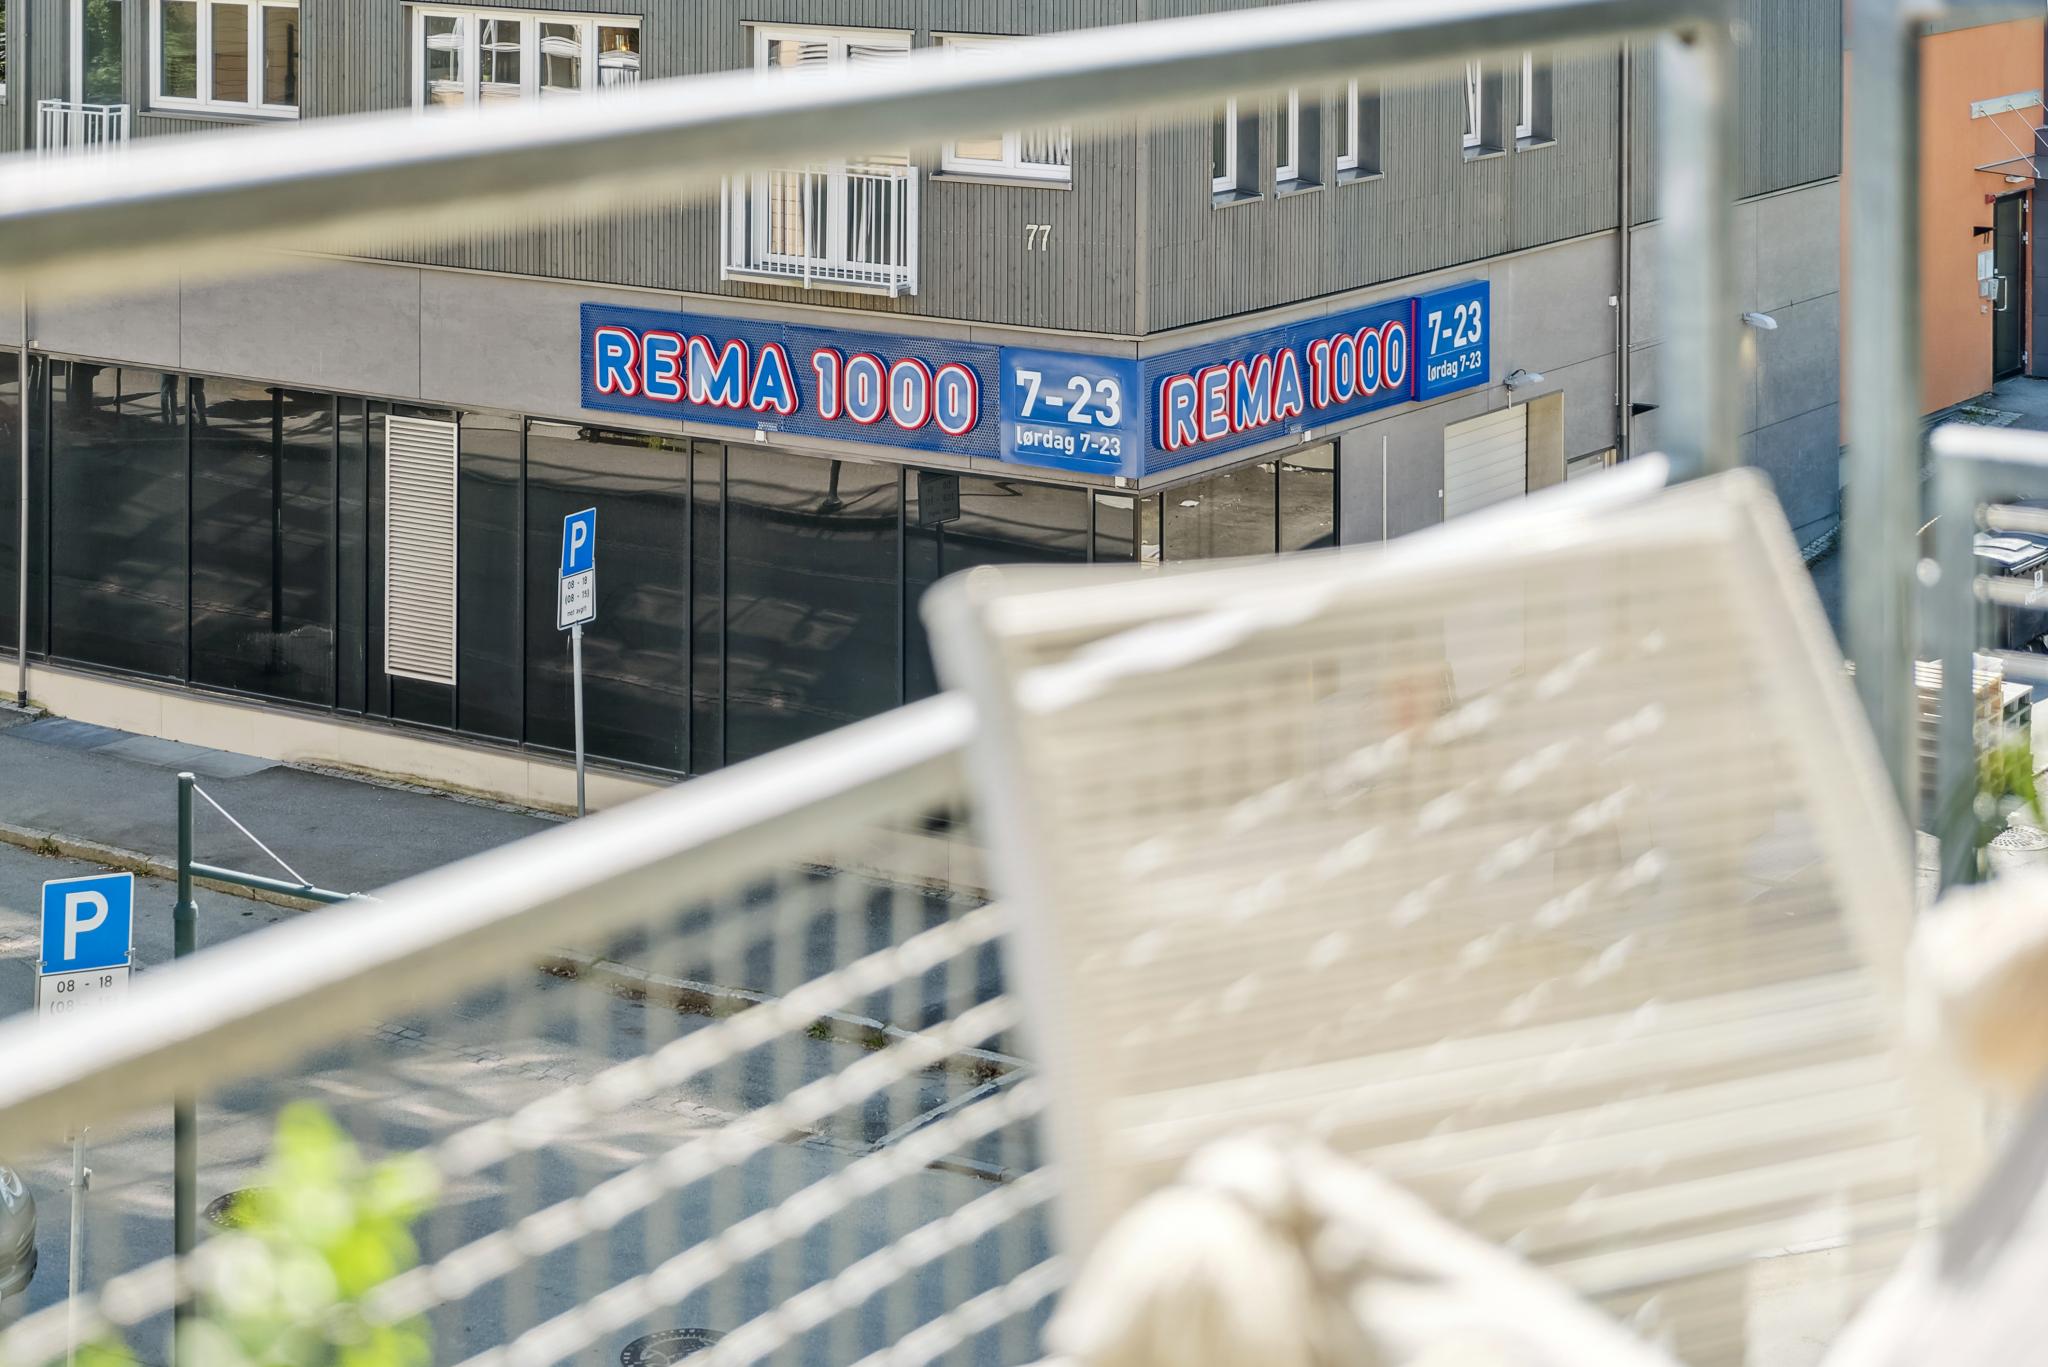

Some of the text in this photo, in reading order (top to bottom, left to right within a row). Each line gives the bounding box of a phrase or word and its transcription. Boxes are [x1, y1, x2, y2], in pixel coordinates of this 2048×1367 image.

[1025, 224, 1052, 251] 77
[1428, 300, 1482, 355] 7-23
[594, 325, 979, 436] REMA 1000
[1160, 320, 1407, 452] REMA 1000
[1428, 351, 1482, 382] lørdag 7-23
[1016, 370, 1121, 427] 7-23
[1016, 425, 1121, 456] lørdag 7-23
[569, 520, 587, 567] P
[64, 890, 109, 961] P
[57, 979, 75, 993] 08
[99, 975, 113, 988] 18
